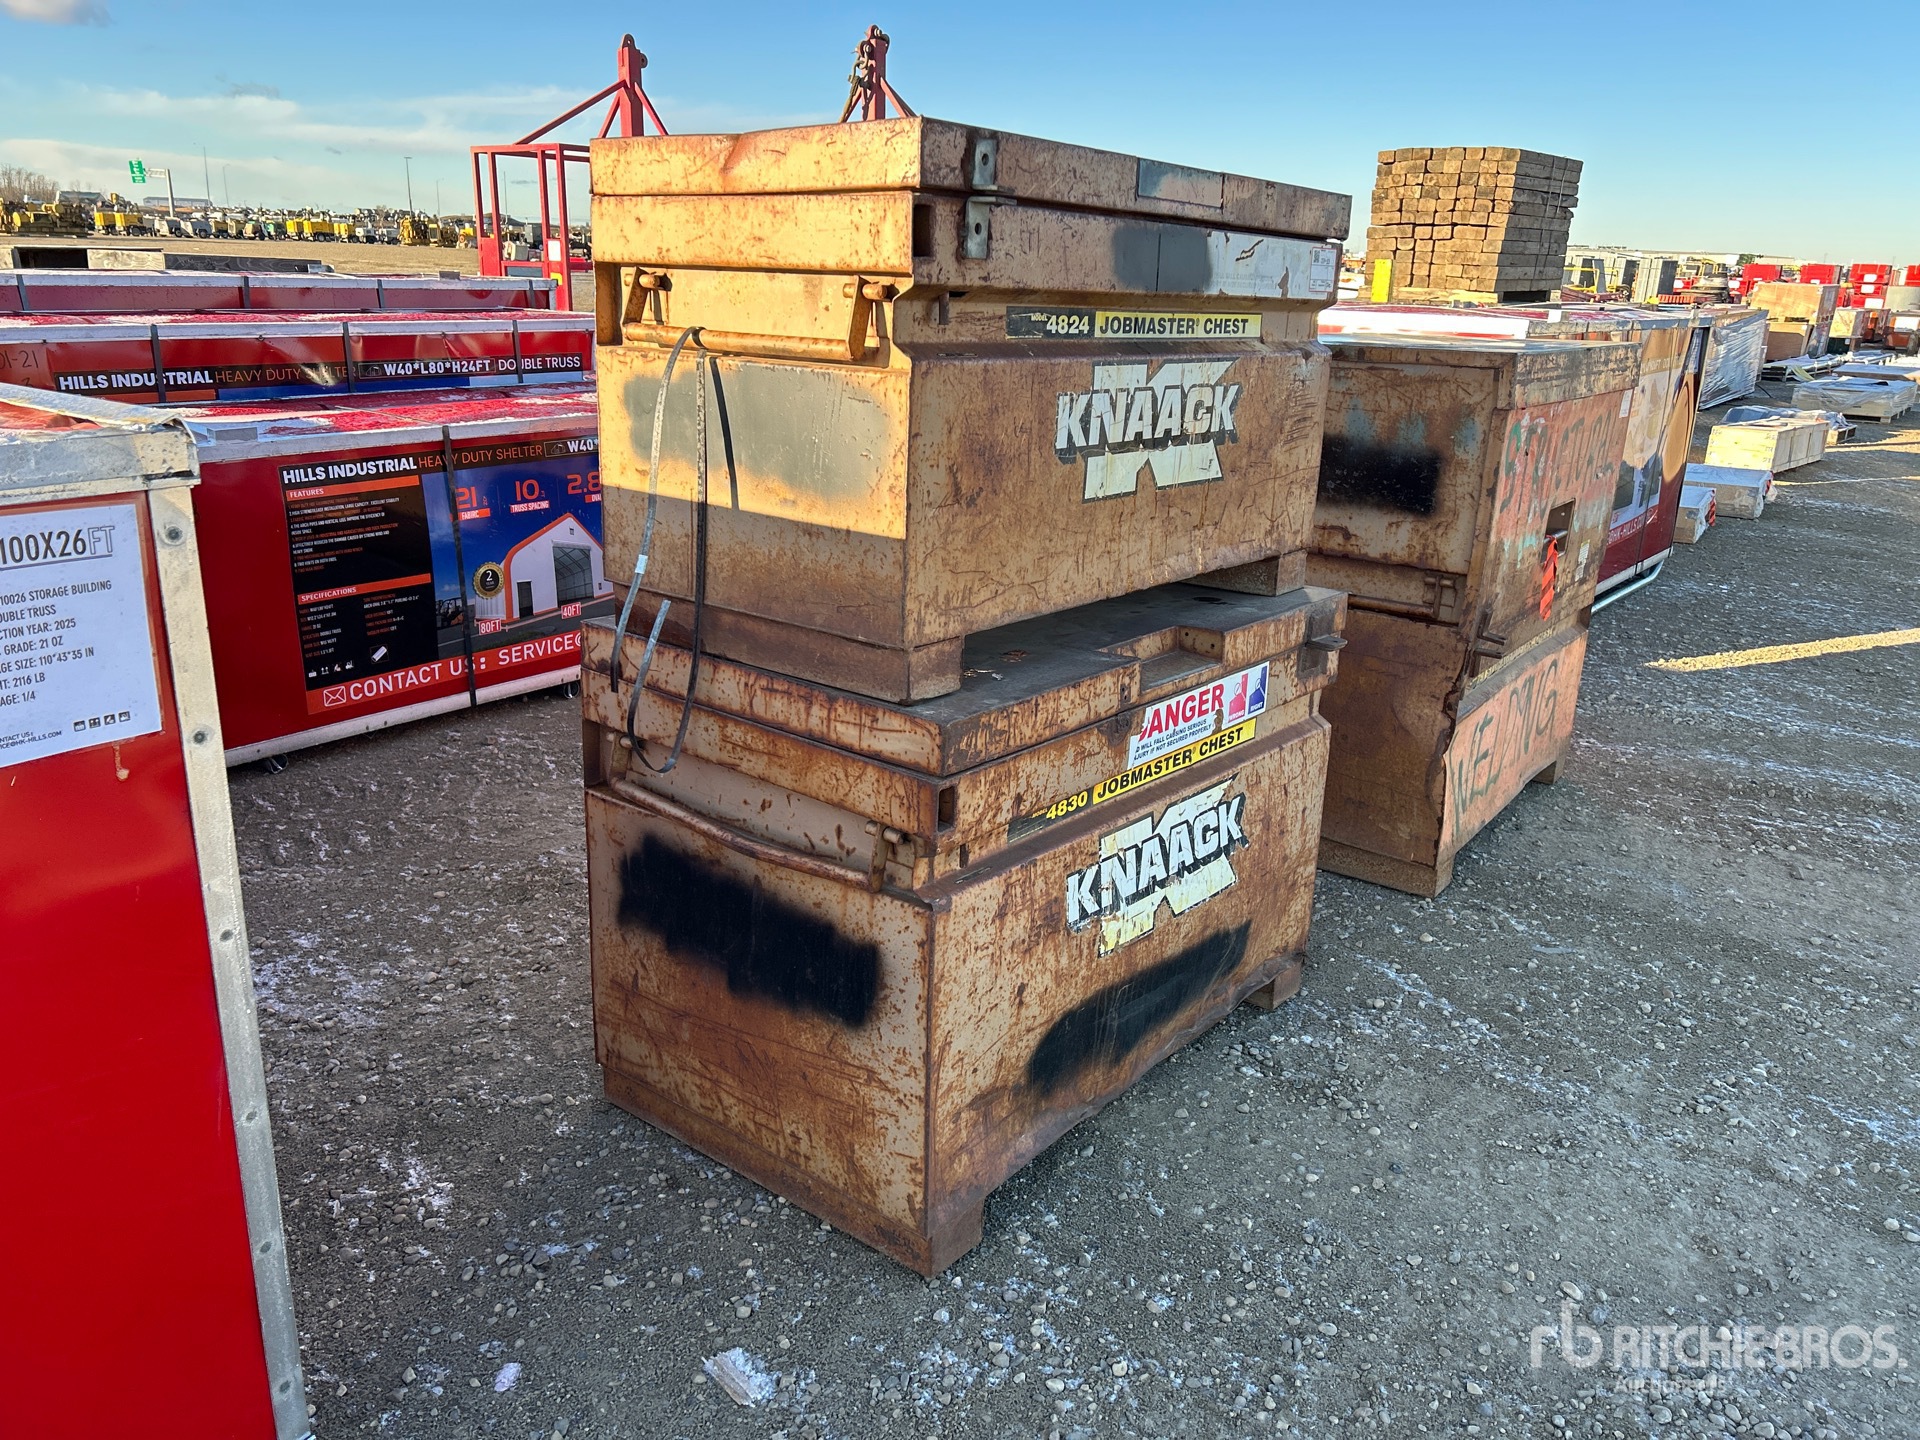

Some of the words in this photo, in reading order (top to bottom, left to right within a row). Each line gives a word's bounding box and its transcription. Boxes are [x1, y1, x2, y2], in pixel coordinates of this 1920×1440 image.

[1046, 315, 1090, 334] 4824
[1203, 317, 1249, 335] CHEST
[59, 374, 109, 390] HILLS
[215, 369, 262, 383] HEAVY
[266, 368, 301, 381] DUTY
[545, 356, 581, 369] TRUSS
[1055, 383, 1241, 450] KNAACK
[283, 466, 326, 484] HILLS
[328, 456, 417, 479] INDUSTRIAL
[461, 450, 493, 464] DUTY
[496, 444, 543, 460] SHELTER
[289, 488, 324, 499] FEATURES
[515, 479, 540, 502] 10
[511, 502, 528, 513] TRUSS
[528, 500, 550, 511] SPACING
[486, 570, 493, 581] 2
[28, 585, 69, 602] STORAGE
[70, 580, 112, 595] BUILDING
[301, 587, 357, 602] SPECIFICATIONS
[27, 604, 57, 619] TRUSS
[563, 603, 580, 617] 40FT
[26, 622, 52, 636] YEAR:
[54, 618, 77, 631] 2025
[480, 620, 500, 634] 80FT
[3, 641, 38, 656] GRADE:
[39, 638, 49, 650] 21
[51, 635, 64, 647] OZ
[14, 657, 37, 671] SIZE:
[84, 646, 95, 658] IN
[12, 674, 32, 688] 2116
[34, 672, 46, 683] LB
[349, 662, 442, 701] CONTACT
[21, 690, 36, 702] 1/4
[1250, 701, 1264, 711] RIGHT
[1228, 709, 1245, 720] WRONG
[1141, 742, 1153, 751] WILL
[1153, 737, 1166, 747] FALL
[1187, 718, 1207, 732] SERIOUS
[1149, 747, 1155, 755] IF
[1155, 743, 1166, 752] NOT
[1166, 734, 1188, 748] SECURED
[1188, 723, 1212, 739] PROPERLY
[1046, 791, 1088, 821] 4830
[1199, 726, 1244, 756] CHEST
[1066, 795, 1244, 923] KNAACK
